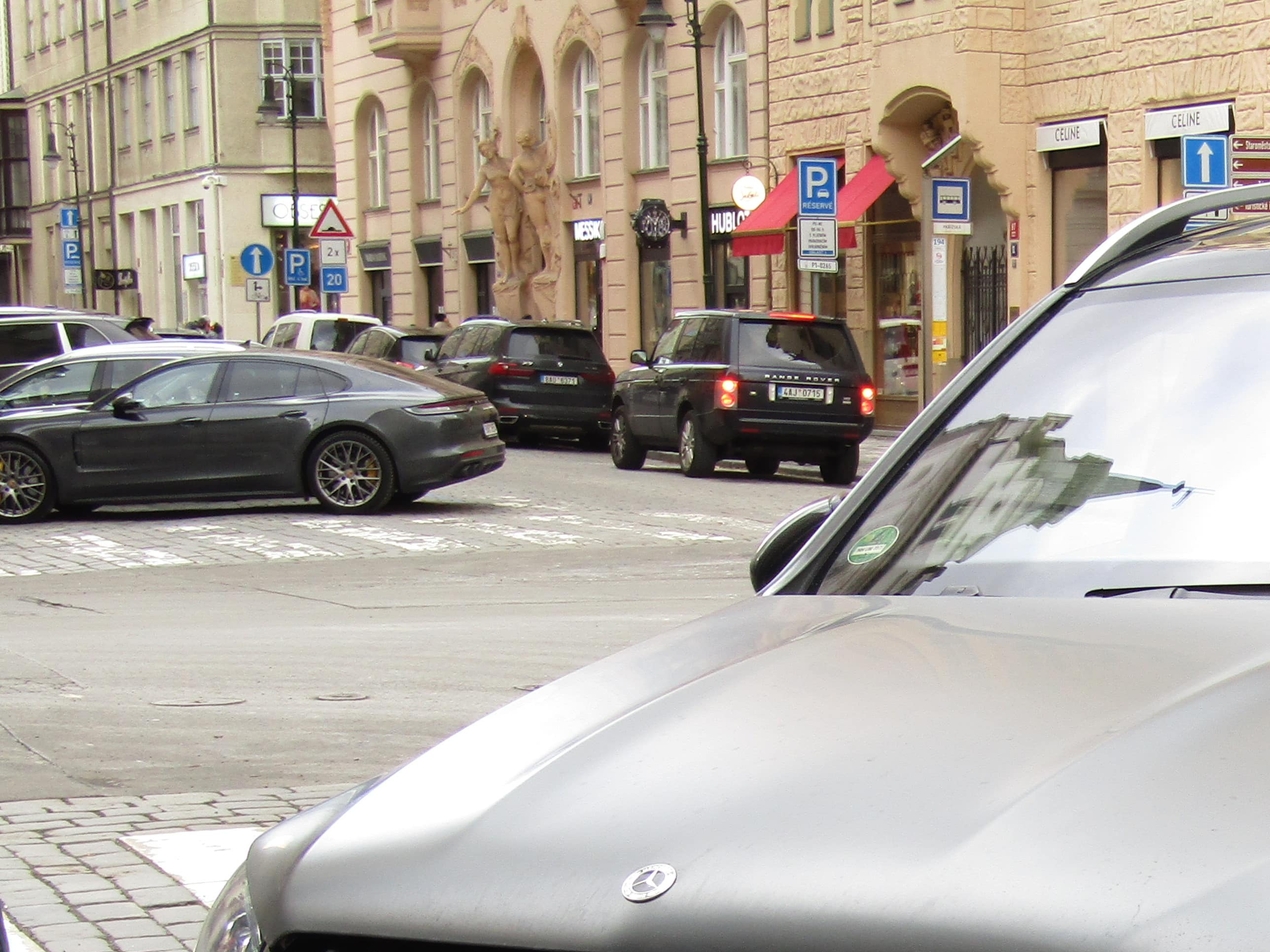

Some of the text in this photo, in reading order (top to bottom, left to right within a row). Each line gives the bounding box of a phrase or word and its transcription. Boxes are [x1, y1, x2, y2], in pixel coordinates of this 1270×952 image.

[1171, 111, 1201, 129] CELINE
[1054, 126, 1080, 142] CELINE
[326, 274, 342, 286] 20
[783, 387, 821, 398] 4AJ 0715
